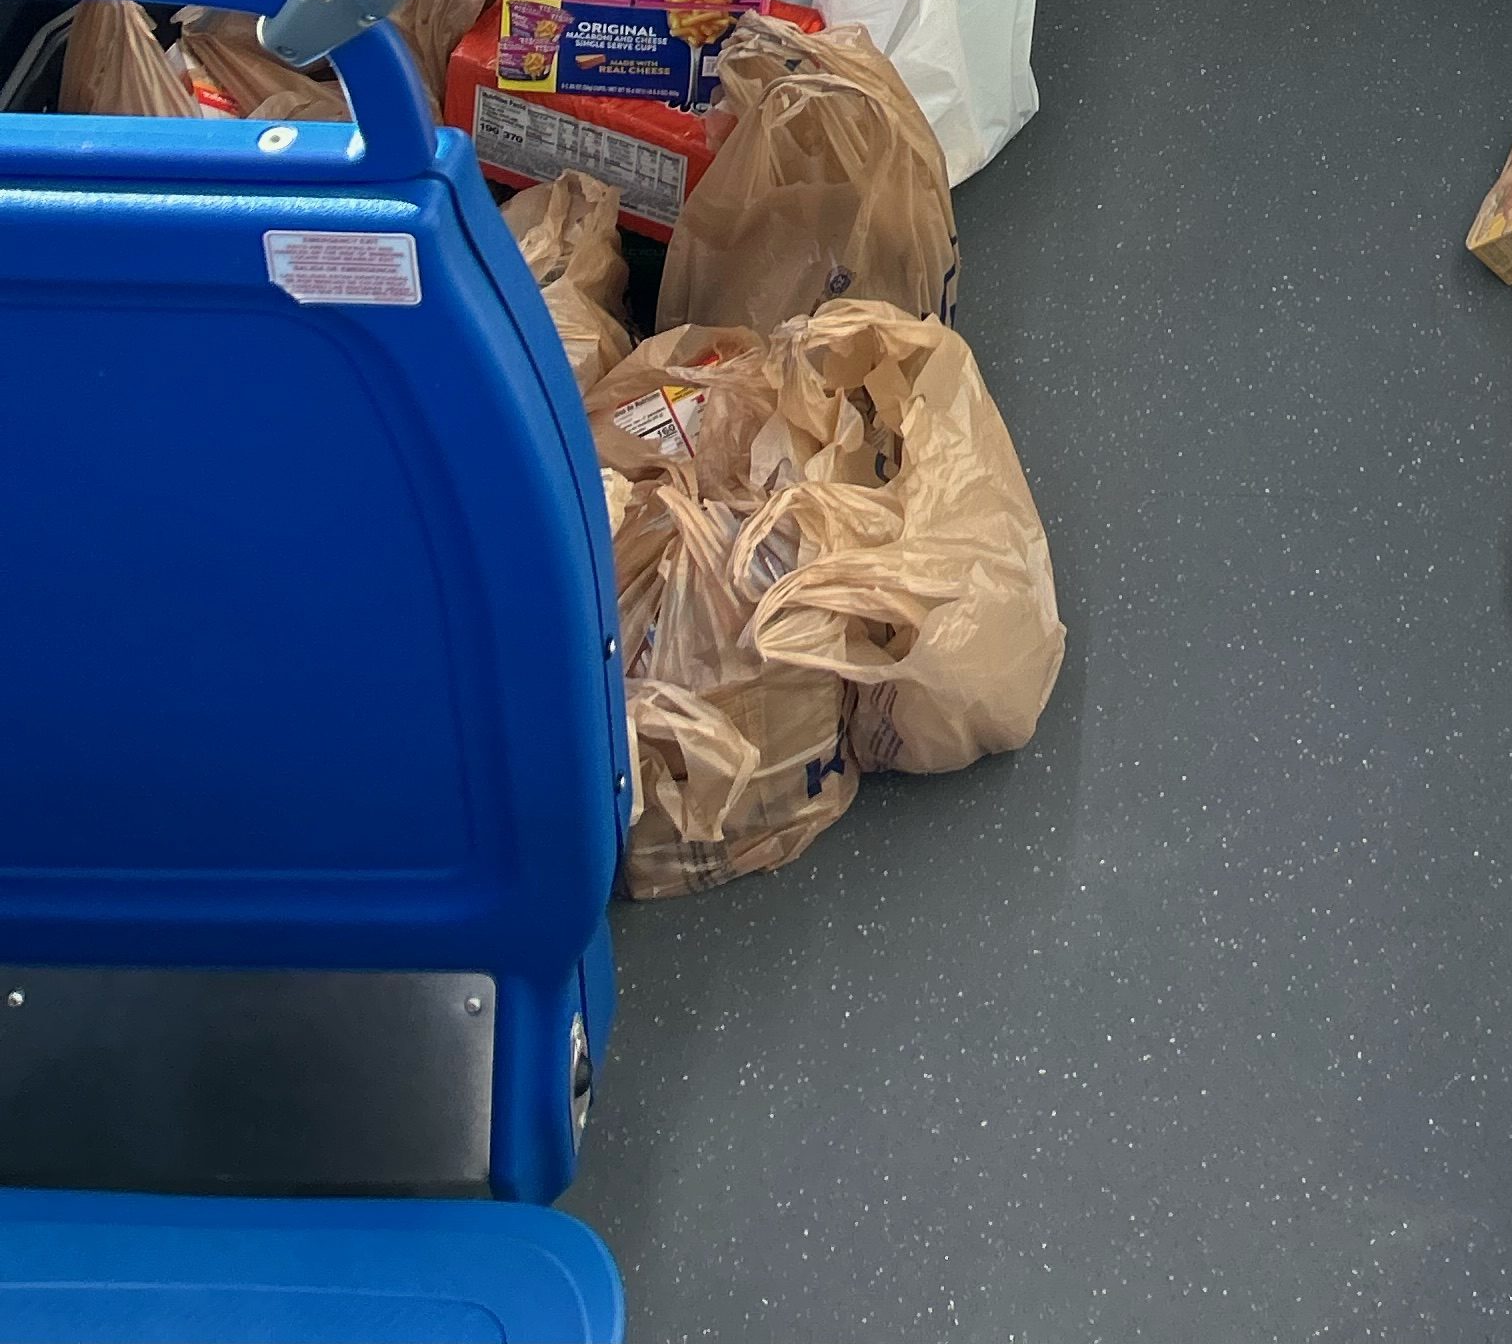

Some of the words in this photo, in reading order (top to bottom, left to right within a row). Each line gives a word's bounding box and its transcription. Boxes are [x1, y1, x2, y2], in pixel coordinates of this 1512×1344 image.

[577, 22, 657, 38] ORIGINAL
[566, 30, 613, 41] MACARONI
[614, 33, 633, 43] AND
[634, 35, 668, 46] CHEESE
[575, 39, 602, 49] SINGLE
[604, 41, 631, 51] SERVE
[632, 42, 658, 52] CUPS
[598, 65, 628, 75] REAL
[630, 66, 671, 76] CHEESE
